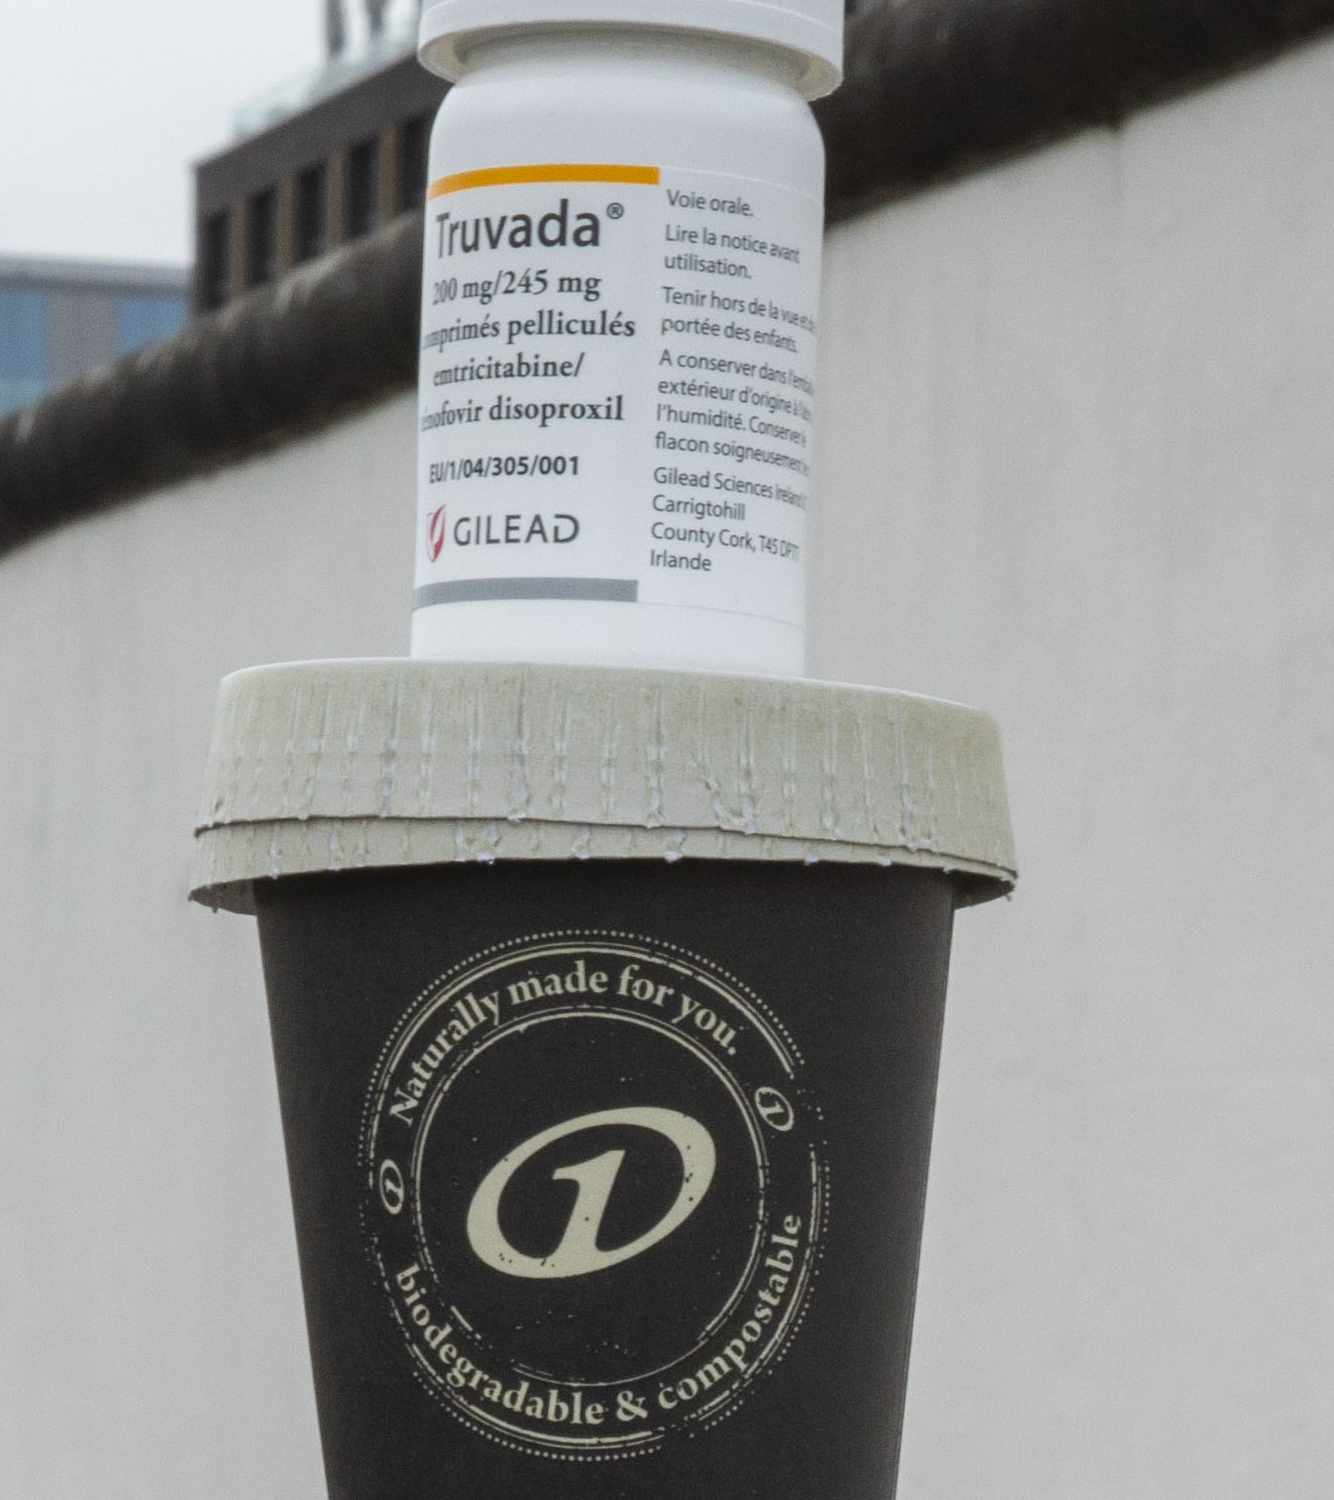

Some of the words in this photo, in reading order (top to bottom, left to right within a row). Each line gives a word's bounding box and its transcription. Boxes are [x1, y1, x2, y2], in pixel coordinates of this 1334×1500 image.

[666, 188, 706, 210] Voie
[710, 197, 754, 217] orale.
[664, 224, 699, 243] Lire
[703, 227, 717, 246] la
[720, 233, 768, 255] notice
[770, 243, 801, 263] avant
[664, 253, 752, 279] utilisation.
[461, 268, 549, 305] mg/245
[557, 276, 602, 302] mg
[662, 286, 707, 306] Tenir
[711, 291, 746, 313] hors
[748, 298, 767, 317] de
[769, 301, 780, 320] la
[506, 308, 636, 345] pelliculés
[661, 318, 721, 337] portée
[724, 321, 752, 342] des
[432, 351, 586, 386] emtricitabine/
[659, 348, 673, 367] A
[677, 353, 757, 377] conserver
[758, 363, 786, 383] dans
[657, 378, 736, 402] extérieur
[488, 394, 625, 428] disoproxil
[655, 431, 710, 454] flacon
[749, 416, 800, 445] Conserver
[428, 455, 581, 485] EU/1/04/305/001
[653, 466, 711, 488] Gilead
[713, 472, 774, 499] Sciences
[652, 494, 747, 522] Carrigtohill
[453, 513, 581, 547] GILEAD
[651, 521, 716, 549] County
[718, 529, 756, 553] Cork,
[758, 534, 779, 555] T45
[650, 548, 713, 572] Irlande
[390, 984, 502, 1127] Naturally
[508, 959, 610, 1006] made
[617, 963, 676, 1007] for
[671, 990, 739, 1057] you.
[394, 1263, 606, 1426] biodegradable
[614, 1390, 650, 1422] &
[657, 1212, 802, 1411] compostable
